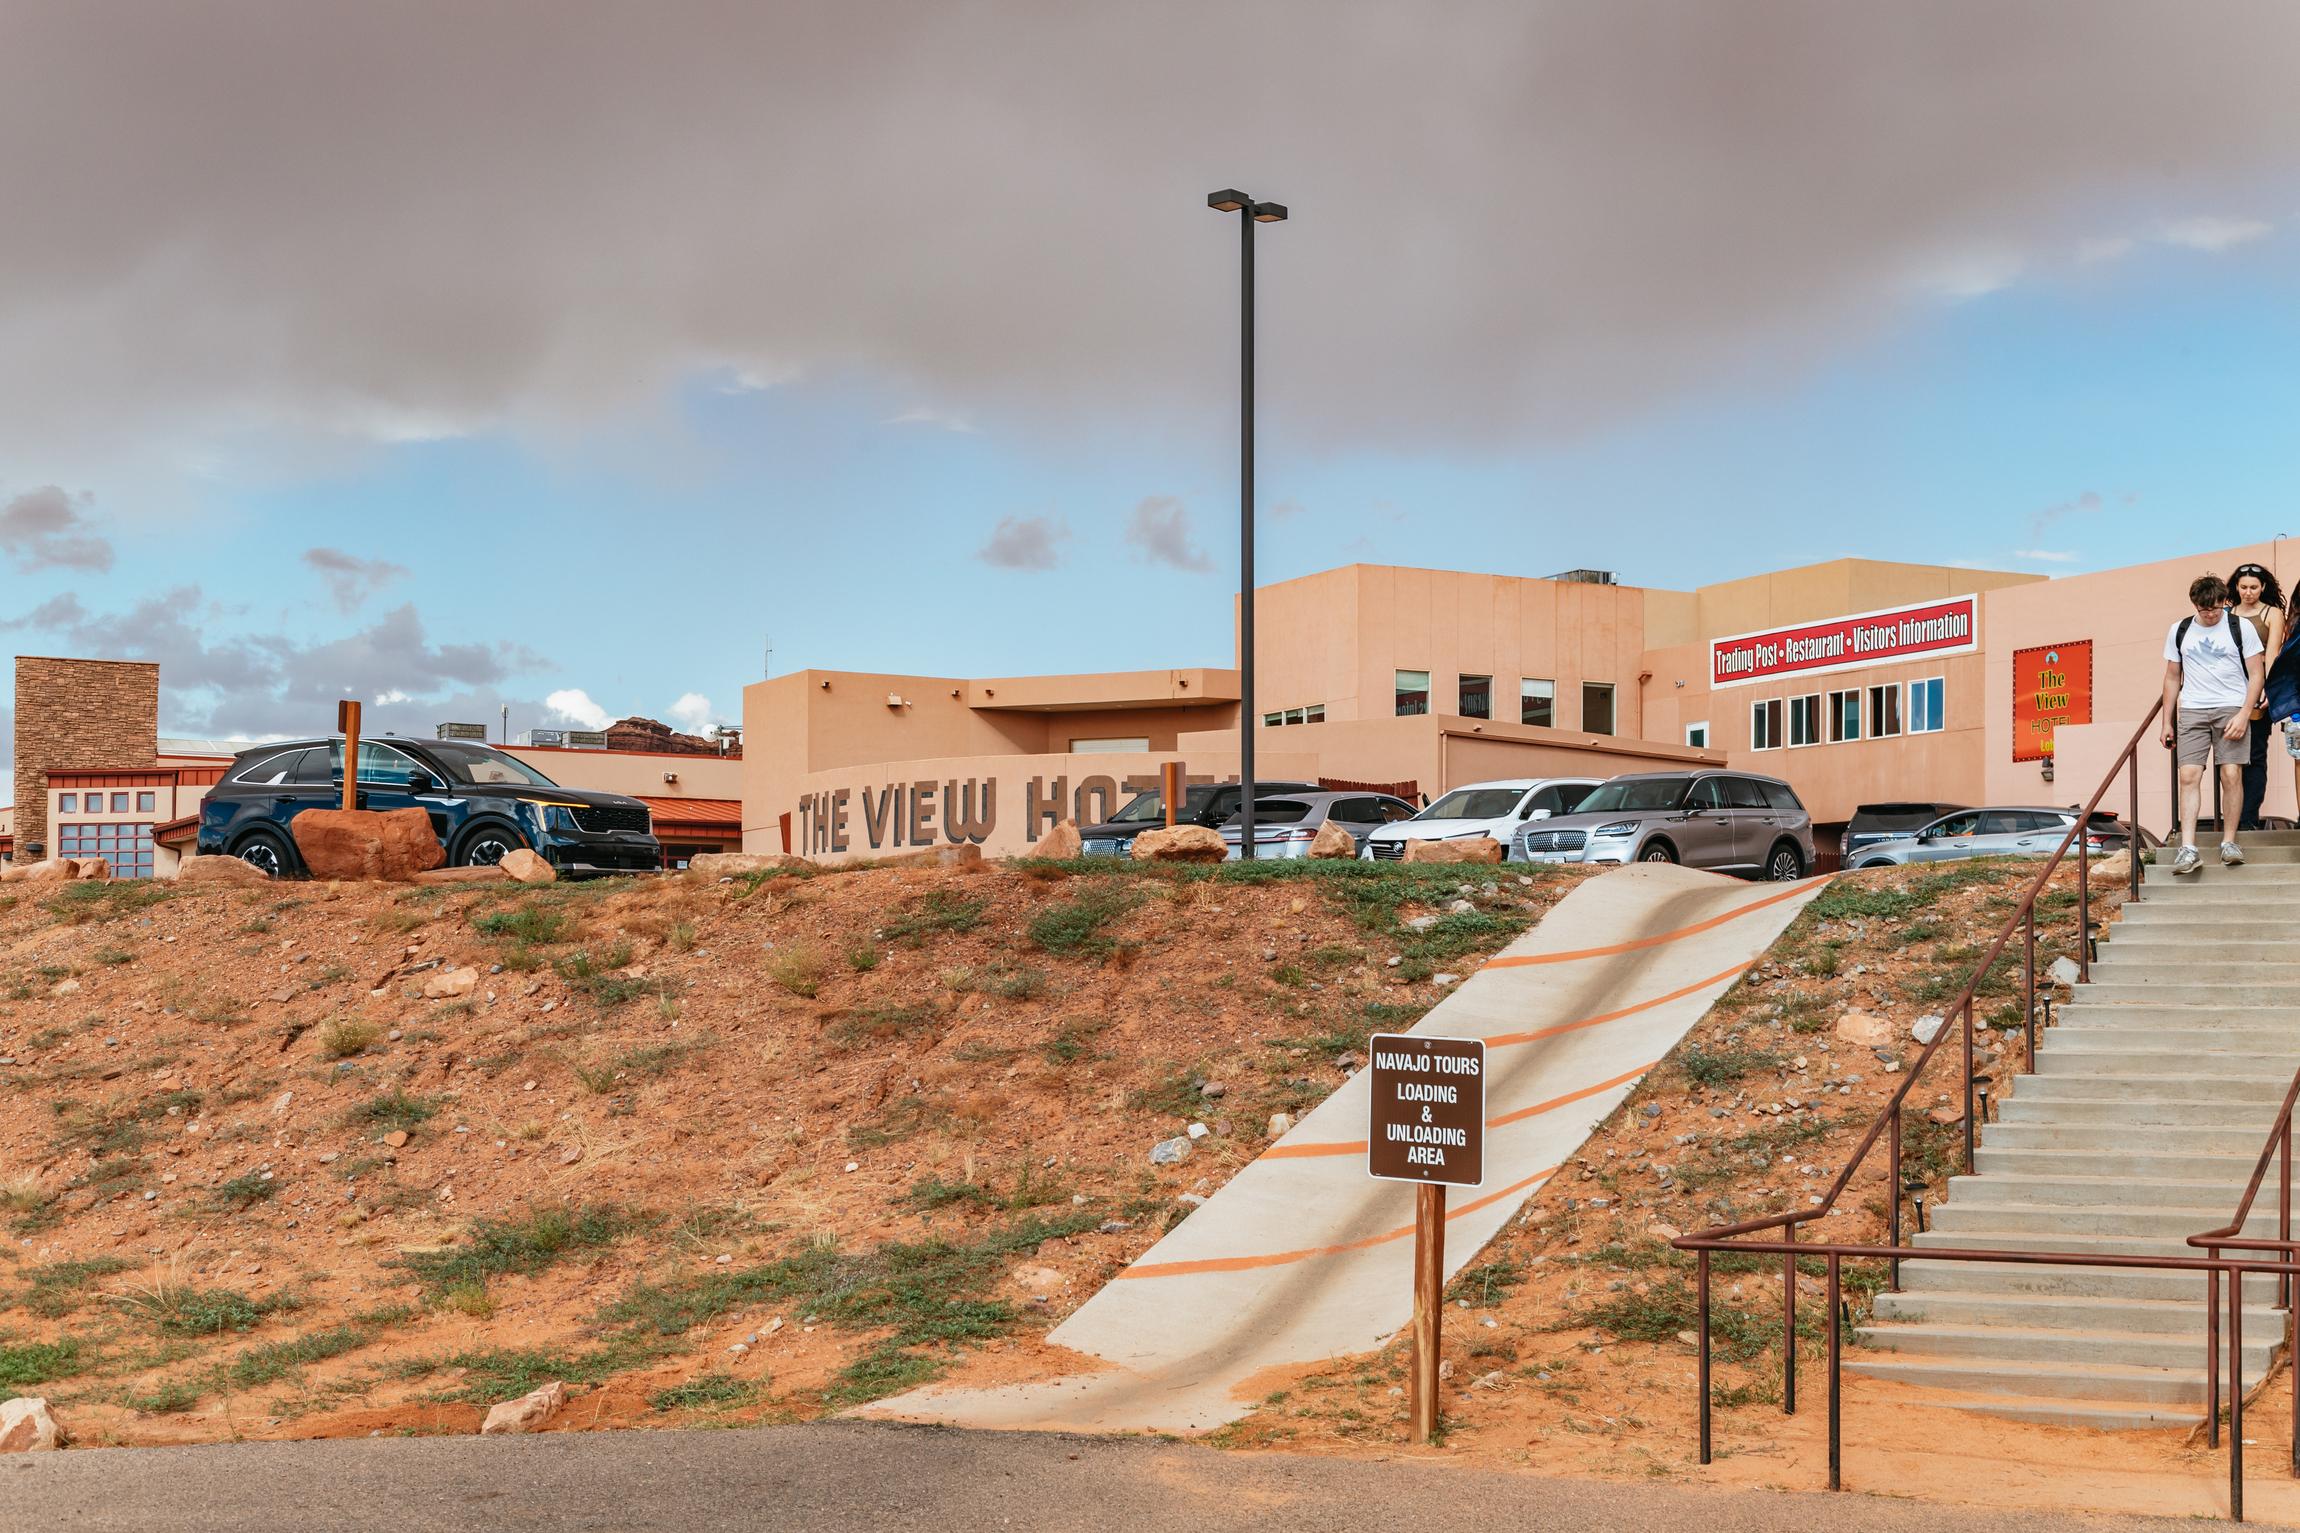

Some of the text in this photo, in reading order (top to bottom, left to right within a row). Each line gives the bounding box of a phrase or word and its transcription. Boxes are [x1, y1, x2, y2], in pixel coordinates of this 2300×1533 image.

[1716, 611, 1968, 675] Trading Post Restaurant Visitors Information
[2038, 669, 2065, 690] The
[2035, 691, 2070, 711] View
[799, 787, 850, 857] THE
[862, 777, 997, 849] VIEW
[1376, 1052, 1480, 1076] NAVAJO TOURS
[1397, 1083, 1457, 1104] LOADING
[1421, 1105, 1433, 1123] &
[1387, 1123, 1466, 1147] UNLOADING
[1407, 1146, 1446, 1166] AREA
